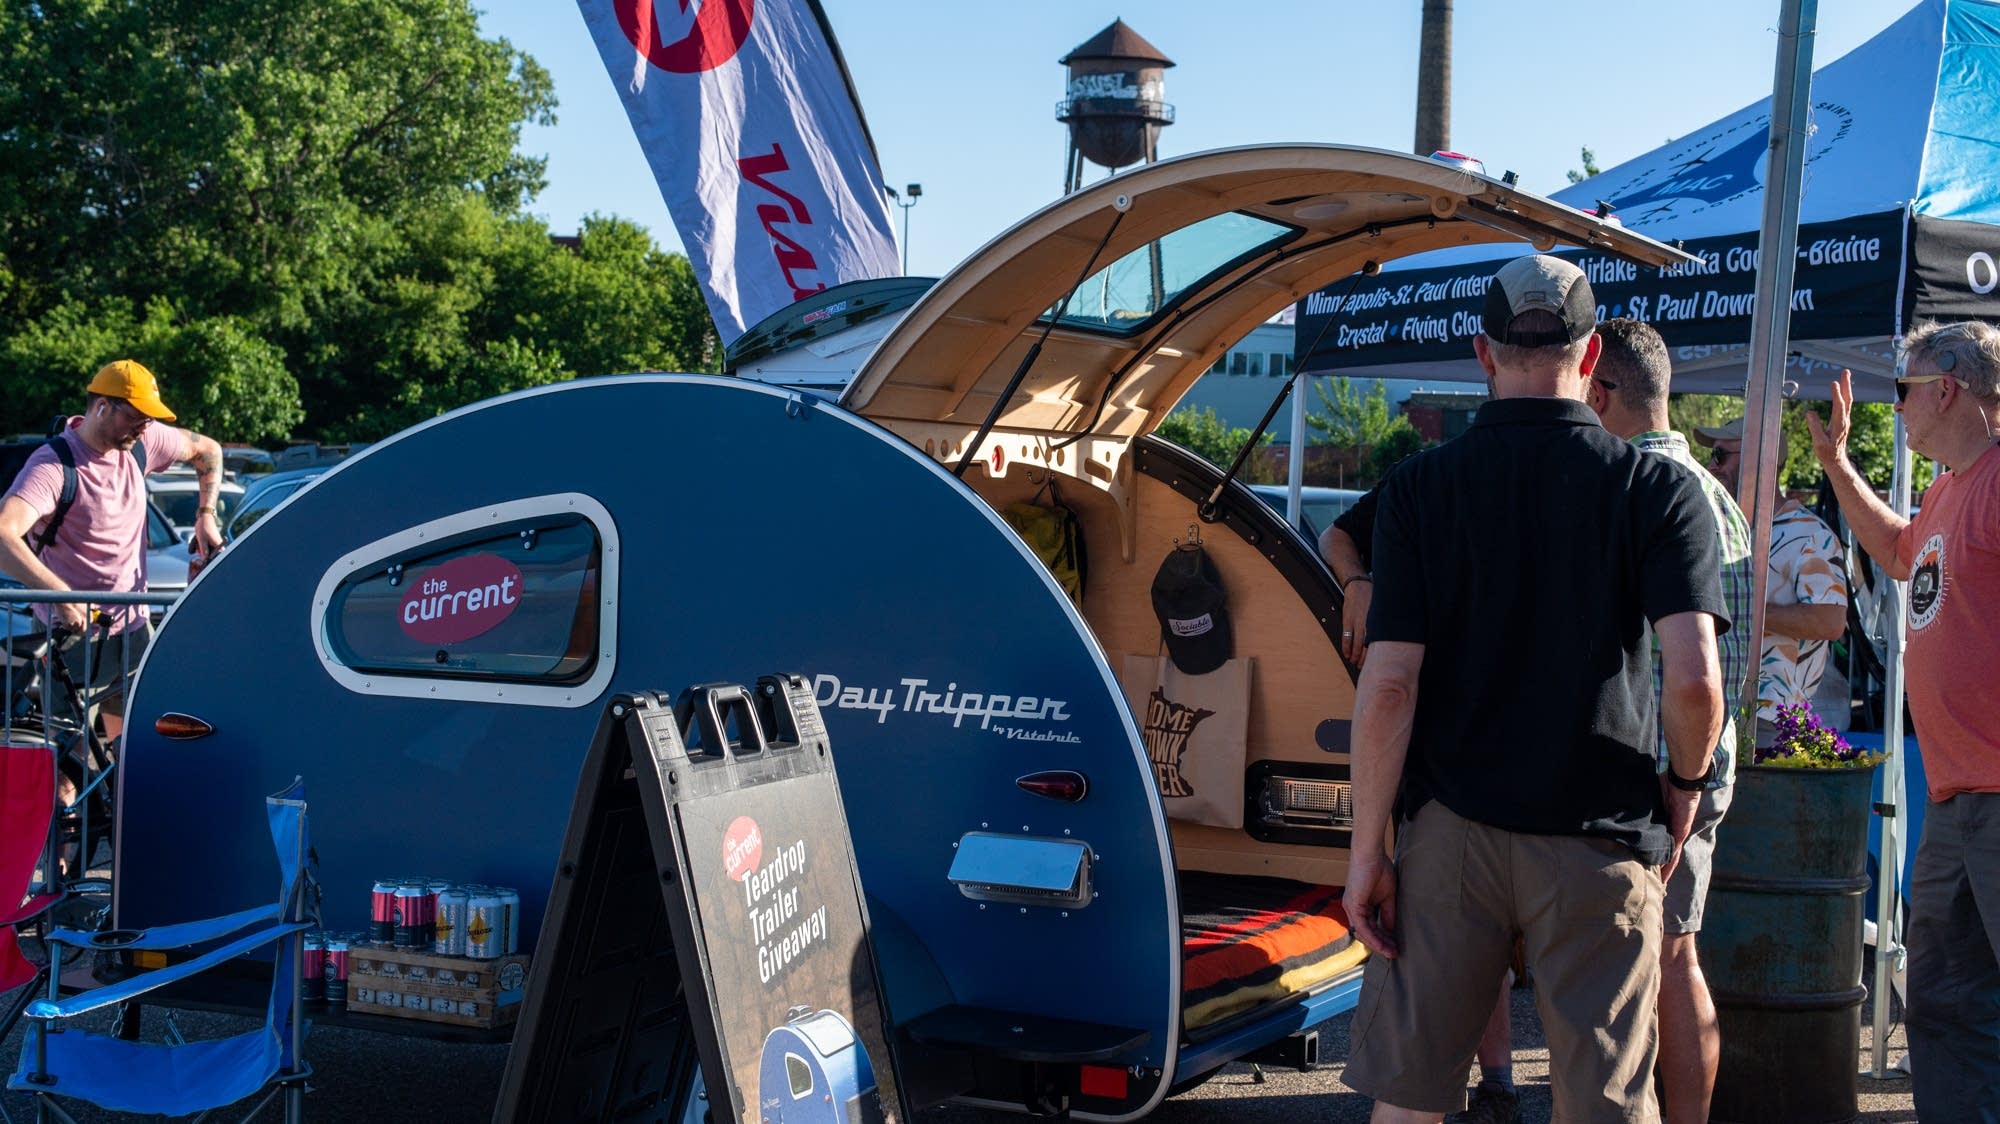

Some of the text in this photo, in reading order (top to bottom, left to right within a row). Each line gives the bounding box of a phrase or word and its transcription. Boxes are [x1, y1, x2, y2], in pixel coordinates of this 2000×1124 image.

[1669, 113, 1771, 161] MINNEAP
[1815, 102, 1853, 142] SAINT PAUL
[1653, 173, 1733, 199] MAC
[1415, 278, 1452, 303] Paul
[1626, 294, 1650, 322] St.
[1656, 291, 1700, 321] Paul
[1337, 310, 1486, 349] Crystal Flying Clou
[403, 576, 516, 624] current
[423, 577, 448, 595] the
[1172, 616, 1210, 632] Sociable
[992, 724, 1082, 744] by Vistabule
[1156, 762, 1189, 797] ER
[726, 837, 737, 852] the
[726, 827, 762, 874] current
[741, 838, 806, 908] Teardrop
[749, 885, 799, 946] Trailer
[757, 904, 827, 984] Giveaway
